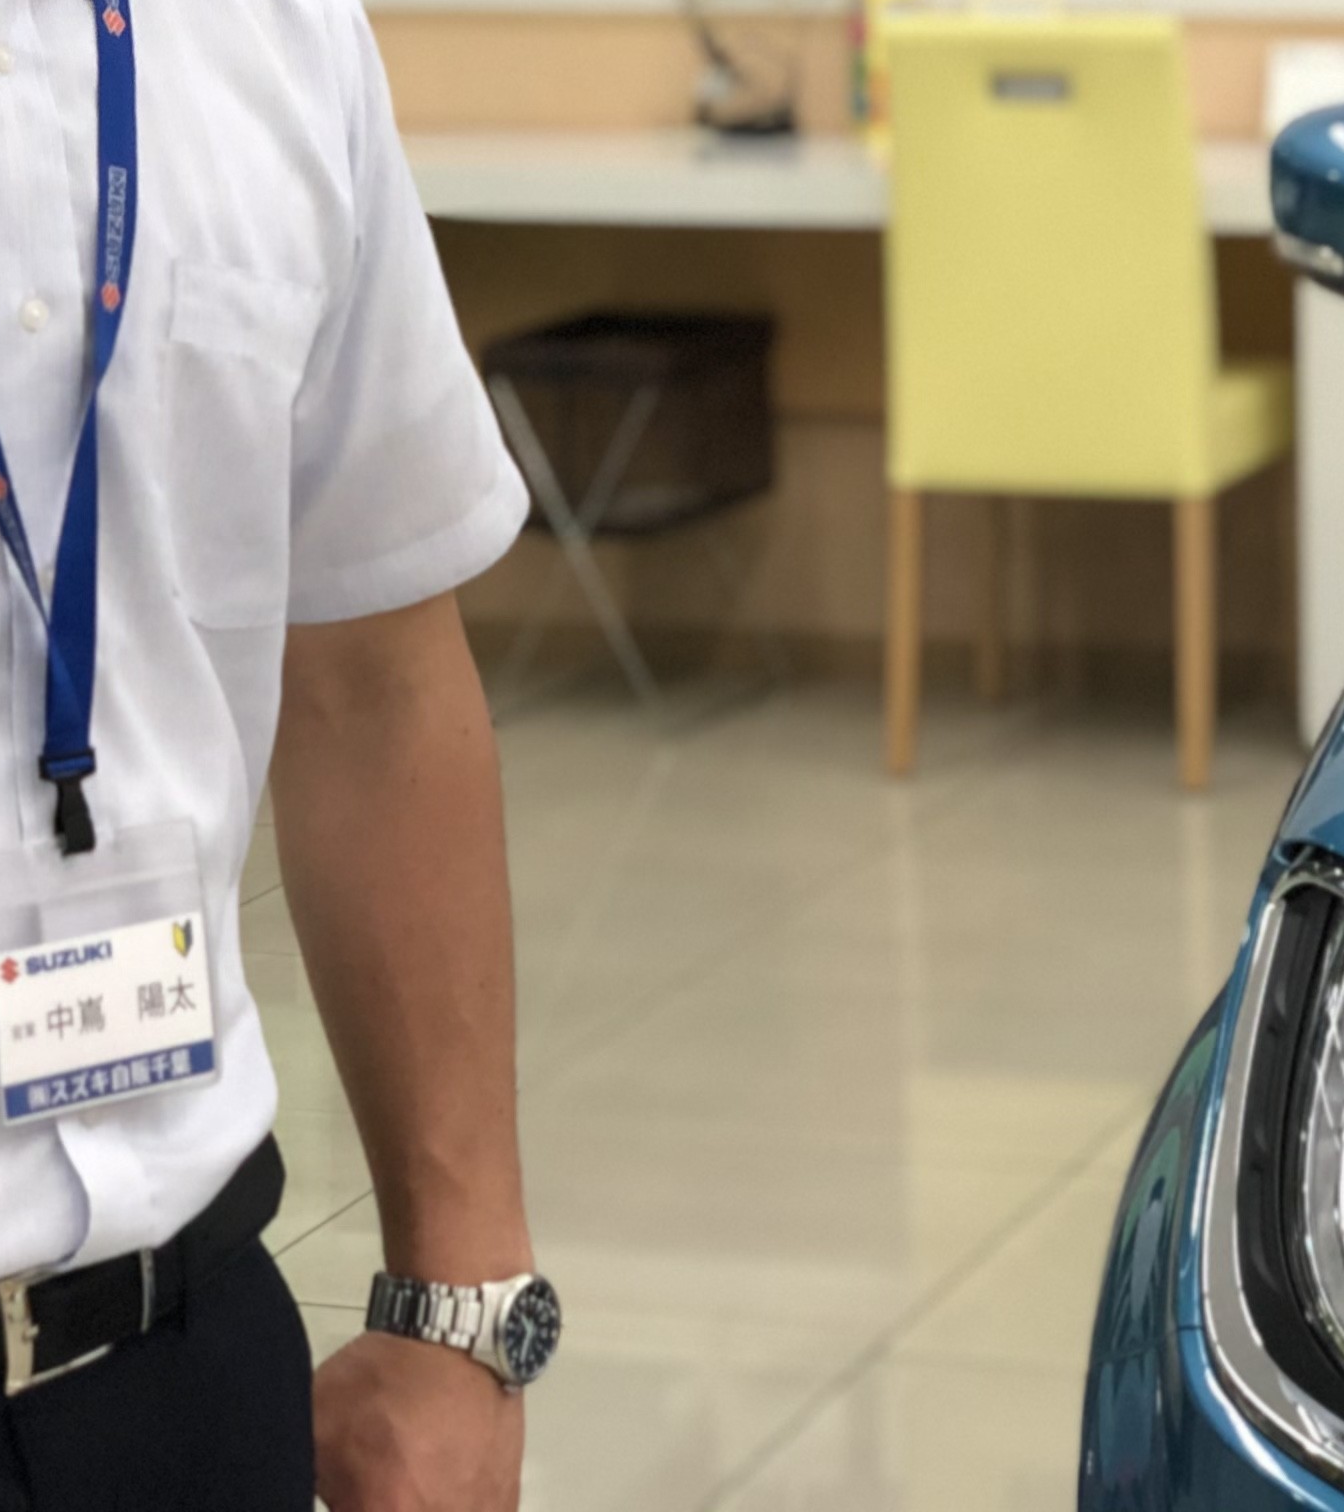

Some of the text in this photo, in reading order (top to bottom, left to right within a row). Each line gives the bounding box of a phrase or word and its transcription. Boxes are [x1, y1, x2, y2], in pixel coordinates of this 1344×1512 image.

[106, 165, 127, 284] SUZUKI
[25, 939, 113, 975] SUZUKI
[137, 976, 196, 1021] 陽太
